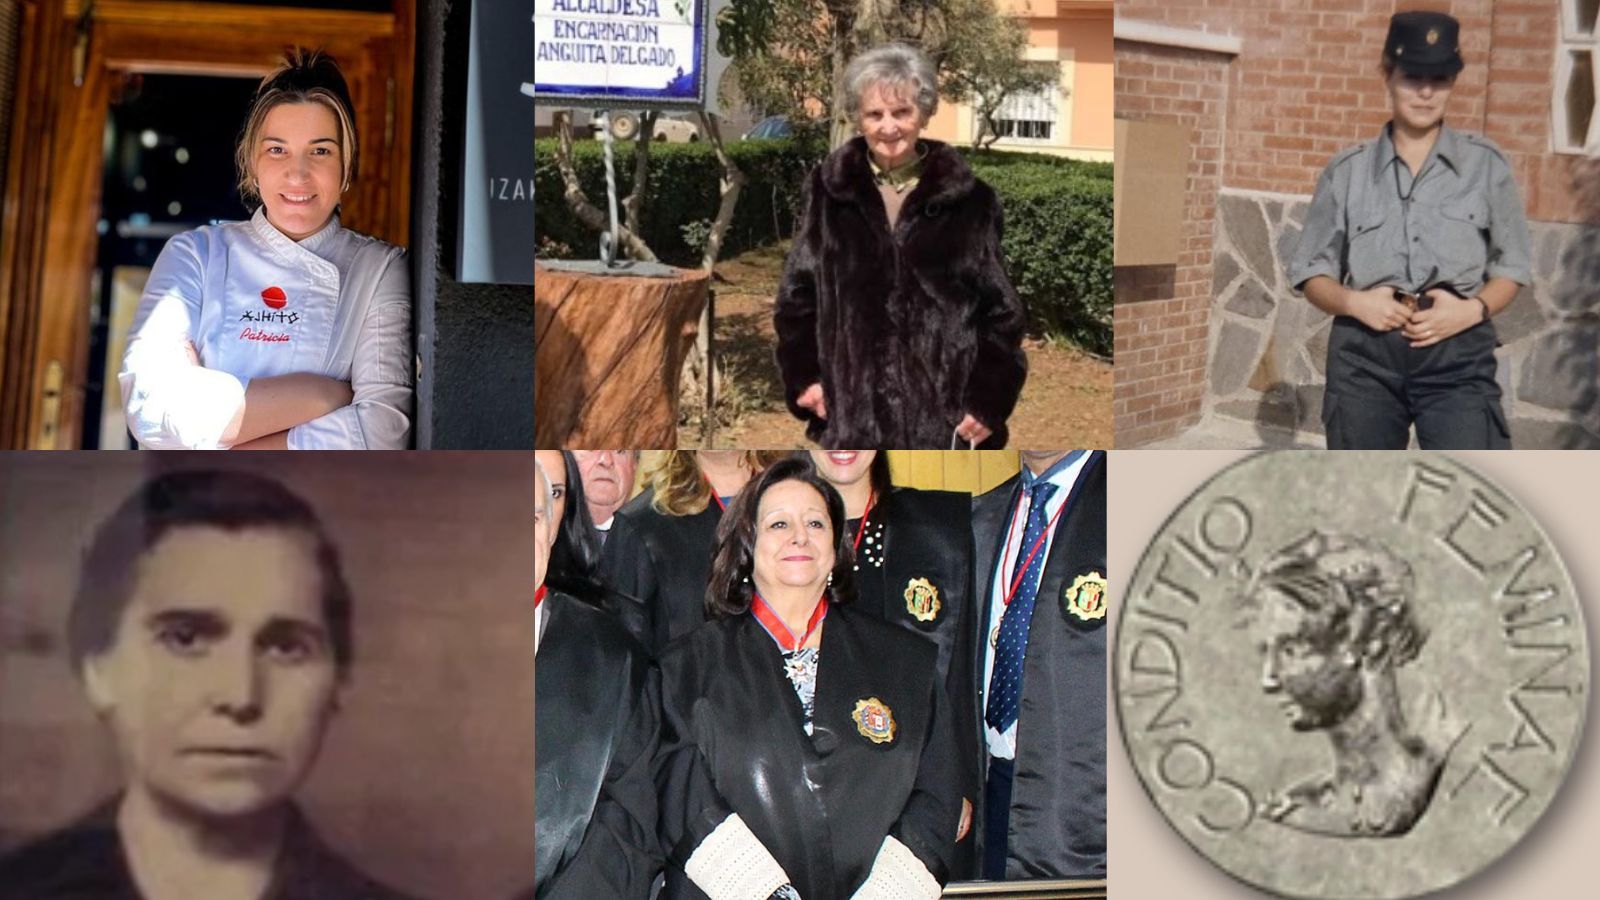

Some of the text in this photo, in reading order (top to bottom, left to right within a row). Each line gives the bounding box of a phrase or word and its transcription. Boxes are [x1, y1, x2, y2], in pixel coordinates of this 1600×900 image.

[552, 0, 660, 17] ALCALDESA
[554, 20, 659, 43] ENCARNACIÓN
[537, 42, 676, 66] ANGUITA DELGADO
[240, 327, 290, 342] Patricia
[1130, 496, 1254, 833] CONDITIO
